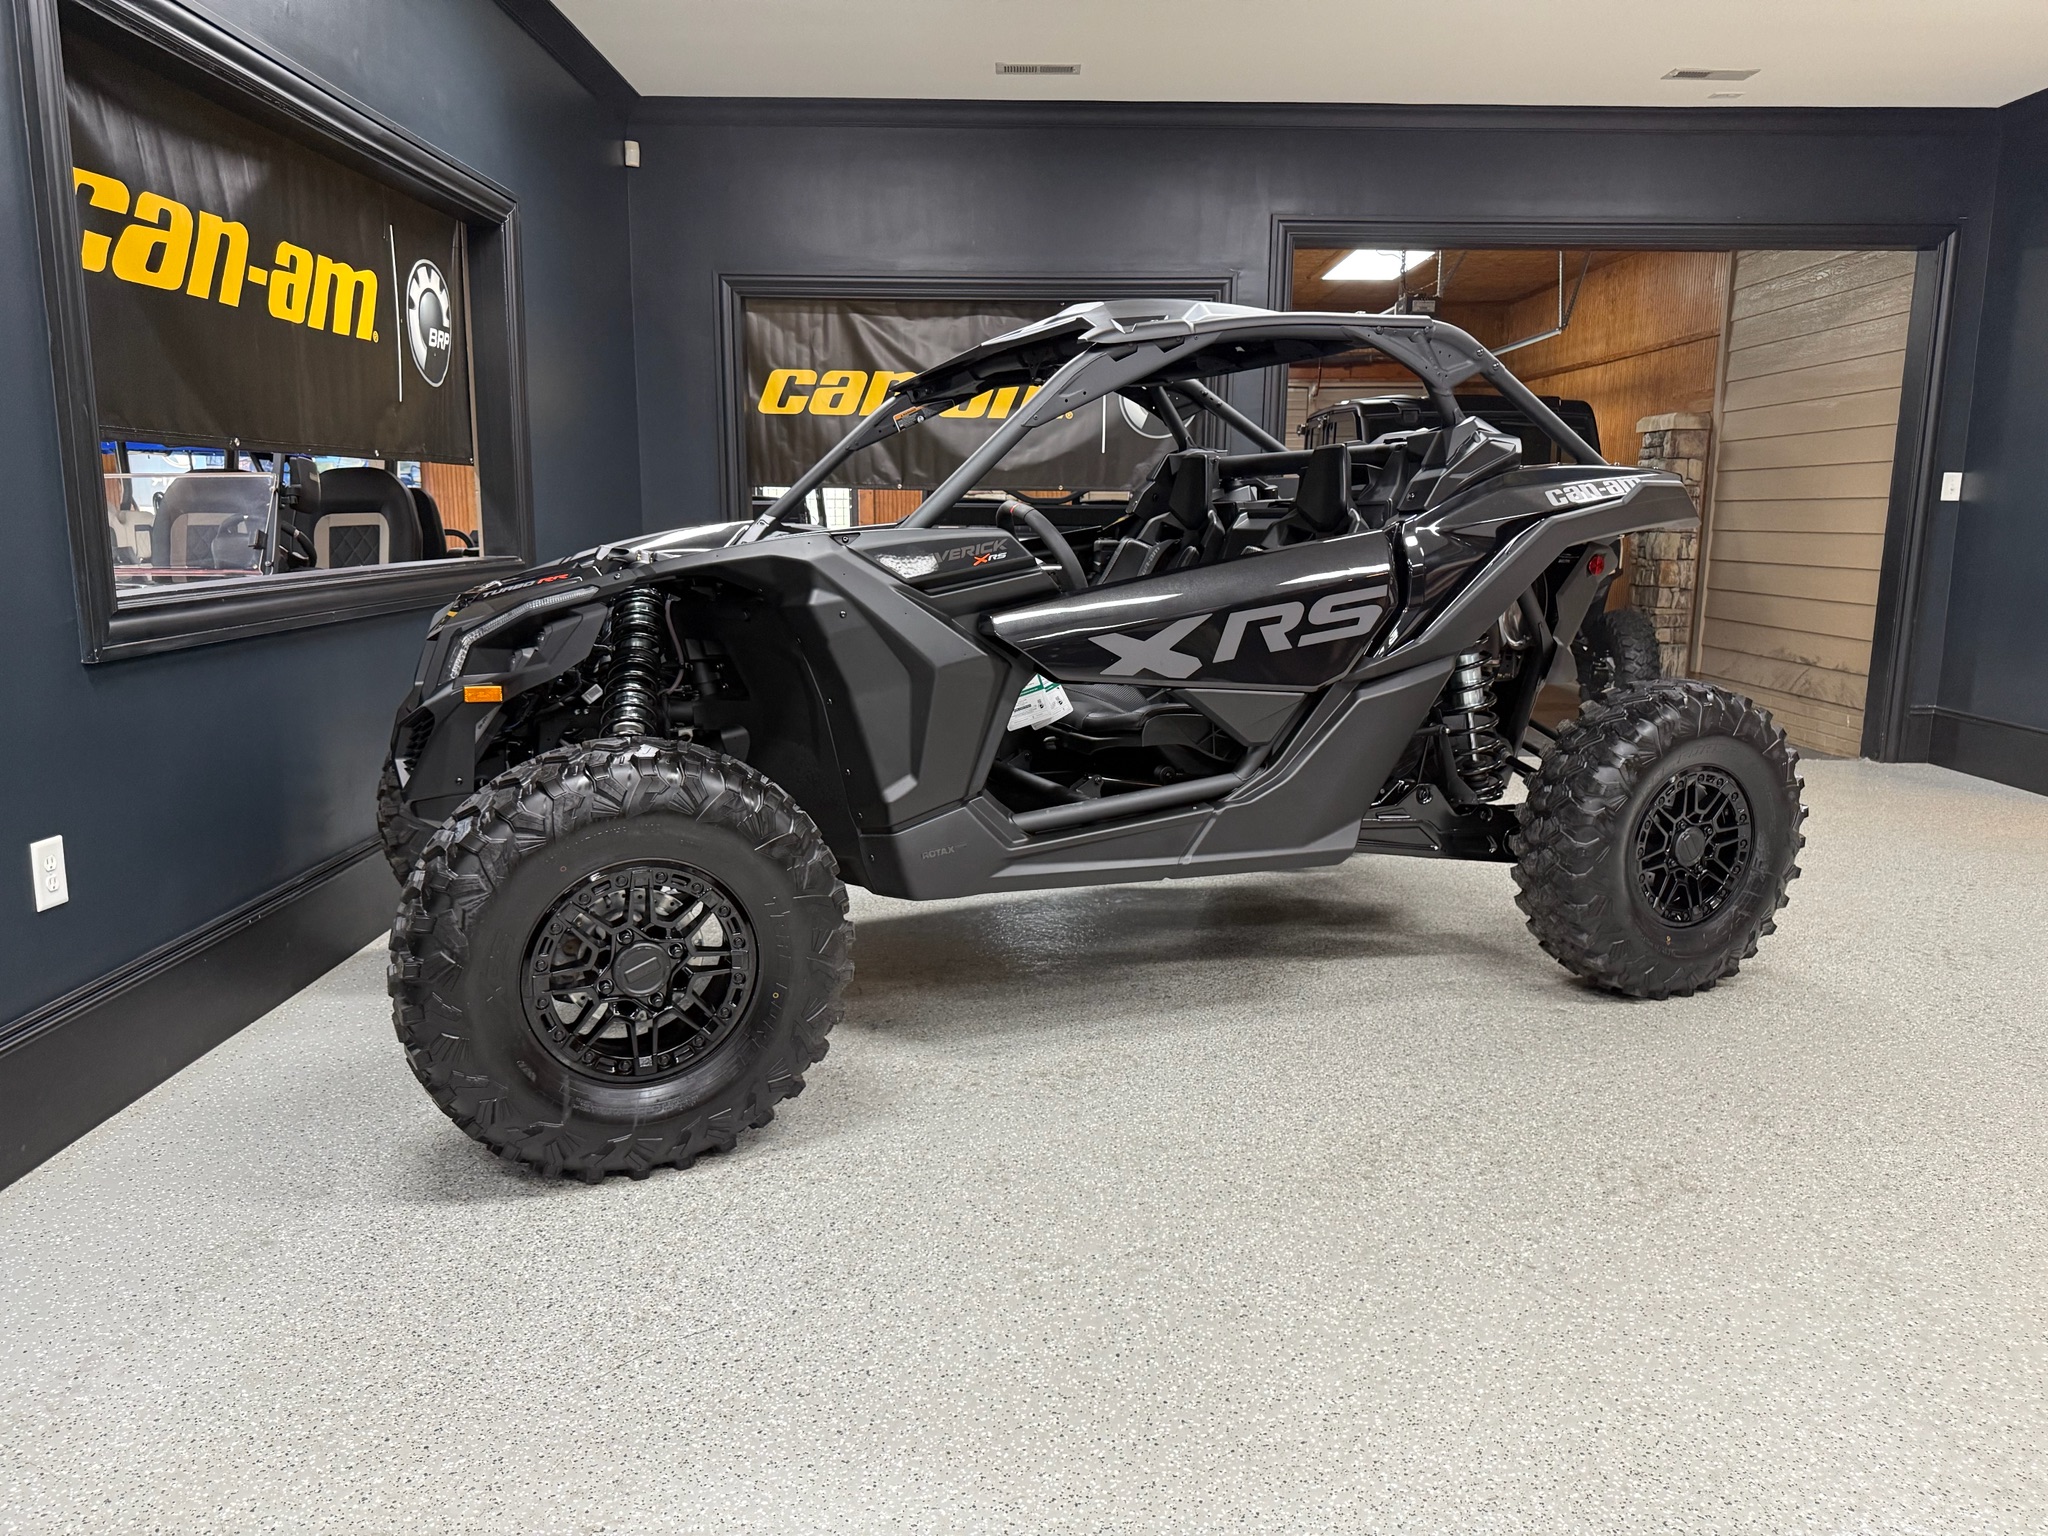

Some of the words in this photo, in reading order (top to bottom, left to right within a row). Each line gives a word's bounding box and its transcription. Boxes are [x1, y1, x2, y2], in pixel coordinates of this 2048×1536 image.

[72, 167, 377, 342] can-am
[428, 327, 450, 351] BRP
[932, 538, 1009, 564] VERICK
[482, 580, 536, 598] TURBO
[537, 573, 569, 585] RR
[921, 845, 956, 860] ROTAX
